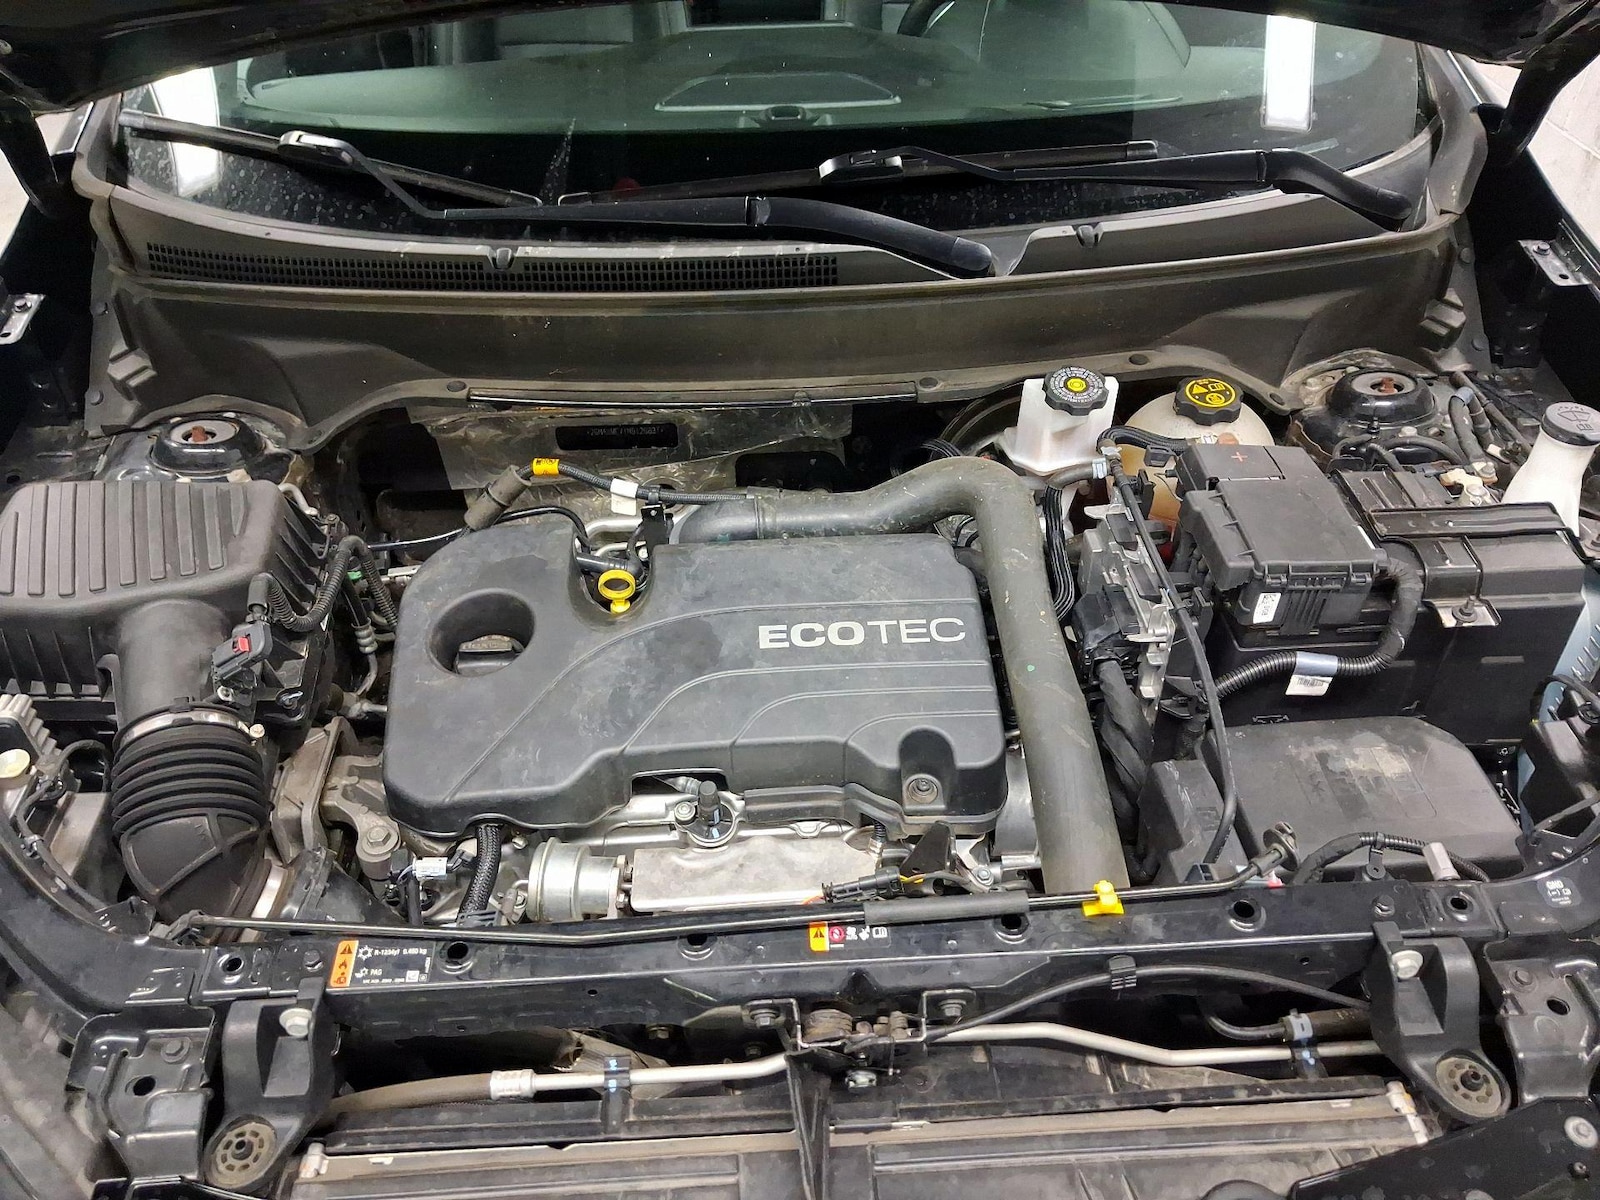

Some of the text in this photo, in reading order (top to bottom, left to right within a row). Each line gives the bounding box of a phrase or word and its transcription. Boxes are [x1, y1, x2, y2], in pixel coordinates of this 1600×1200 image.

[758, 617, 966, 649] ECOTEC
[419, 947, 428, 955] kg
[370, 968, 382, 976] PAG
